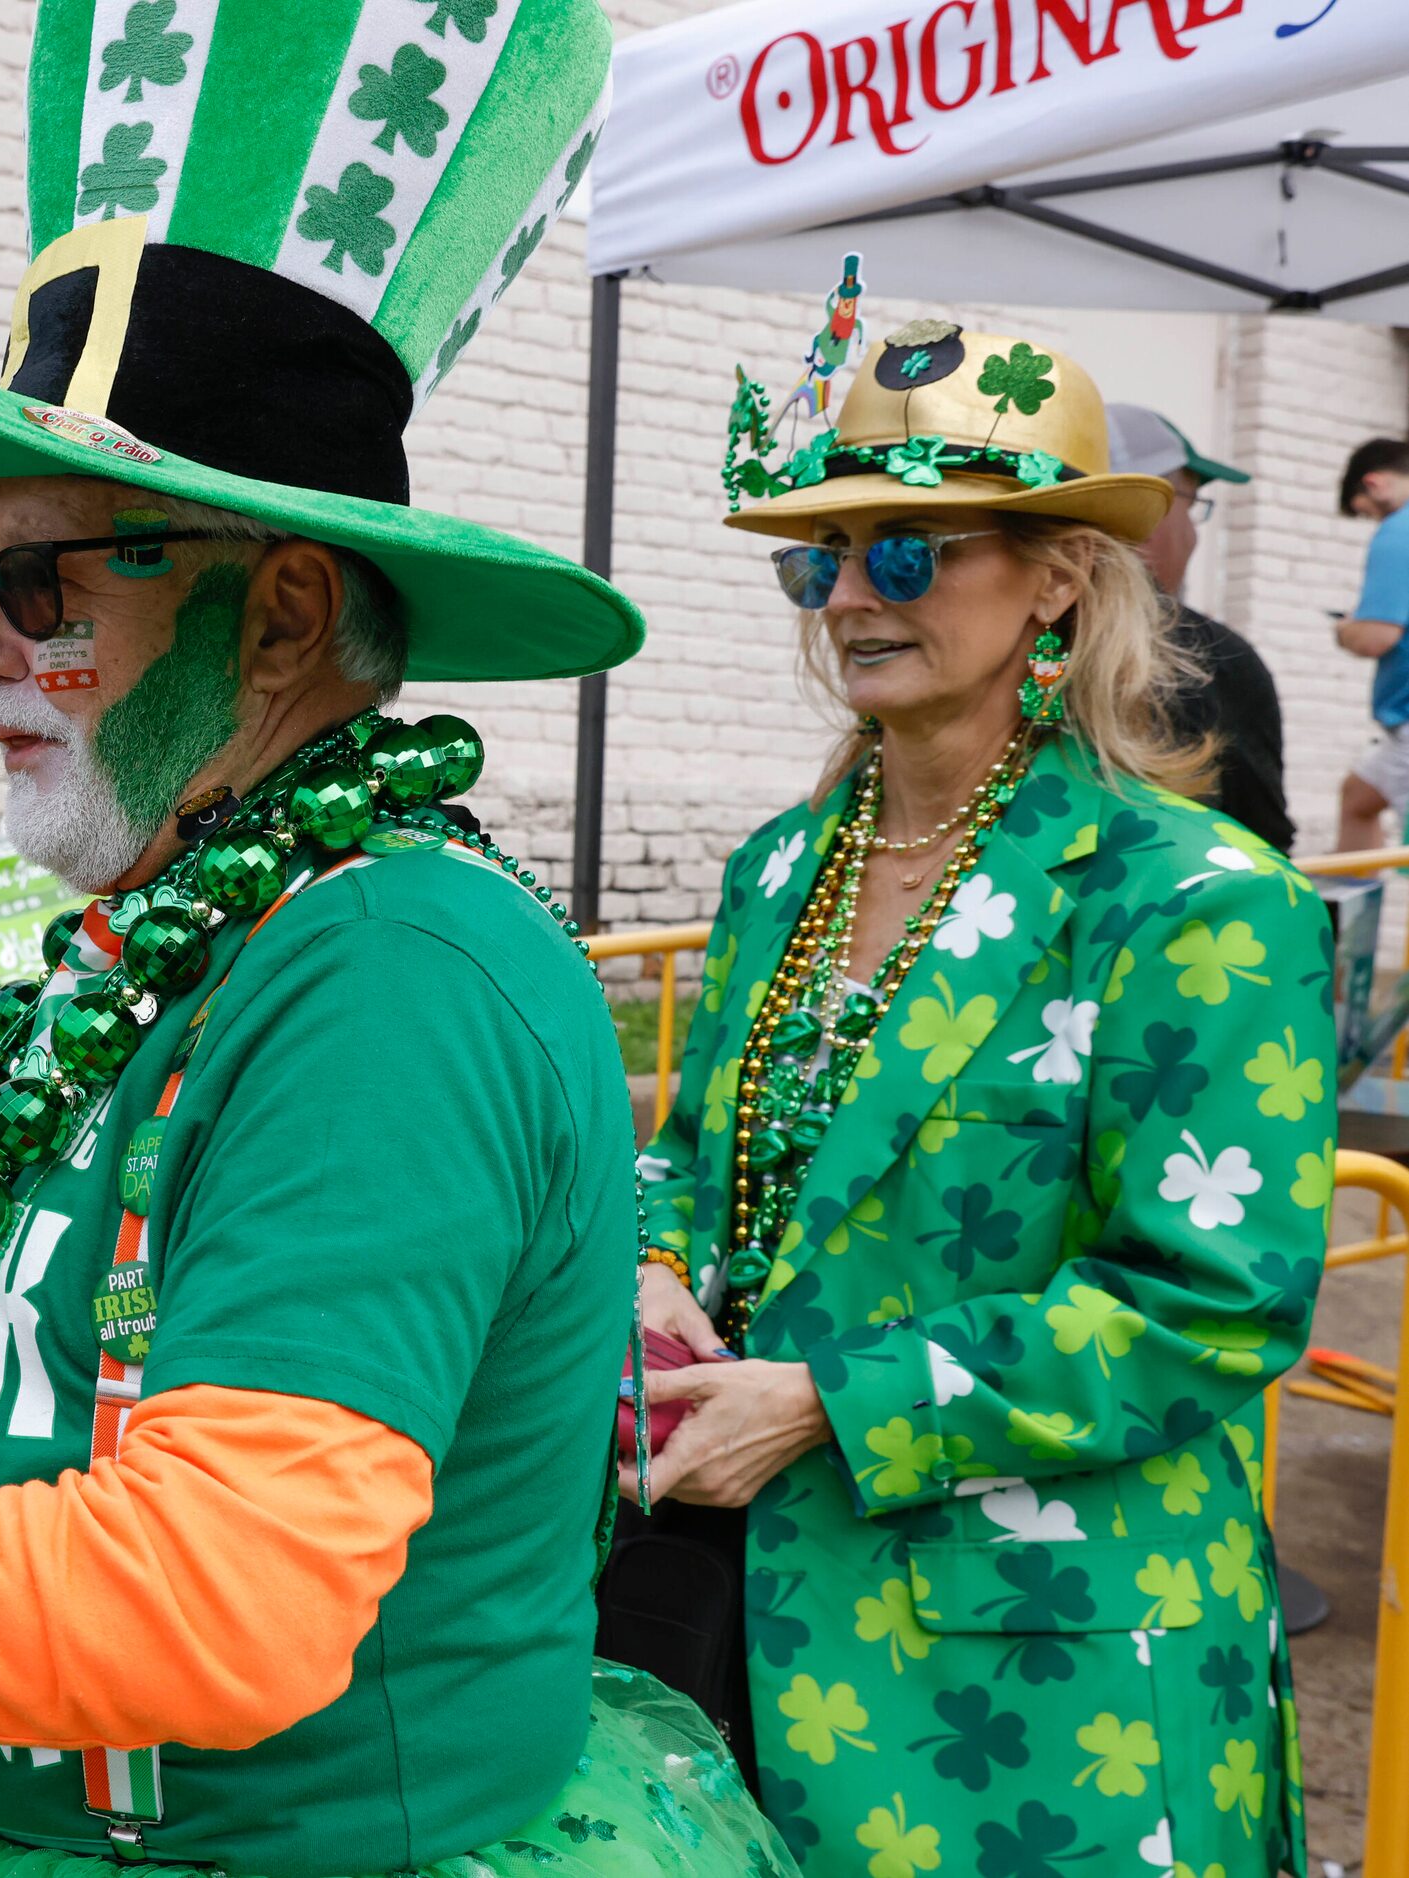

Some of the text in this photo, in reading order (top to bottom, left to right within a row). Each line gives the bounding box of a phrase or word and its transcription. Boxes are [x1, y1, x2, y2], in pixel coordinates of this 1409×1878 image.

[42, 412, 87, 434] Chair
[46, 641, 75, 649] HAPPY
[50, 650, 88, 659] PATTY'S
[127, 1136, 163, 1156] HAPP
[123, 1170, 155, 1199] DA
[108, 1268, 144, 1292] PART
[99, 1312, 157, 1341] all troub
